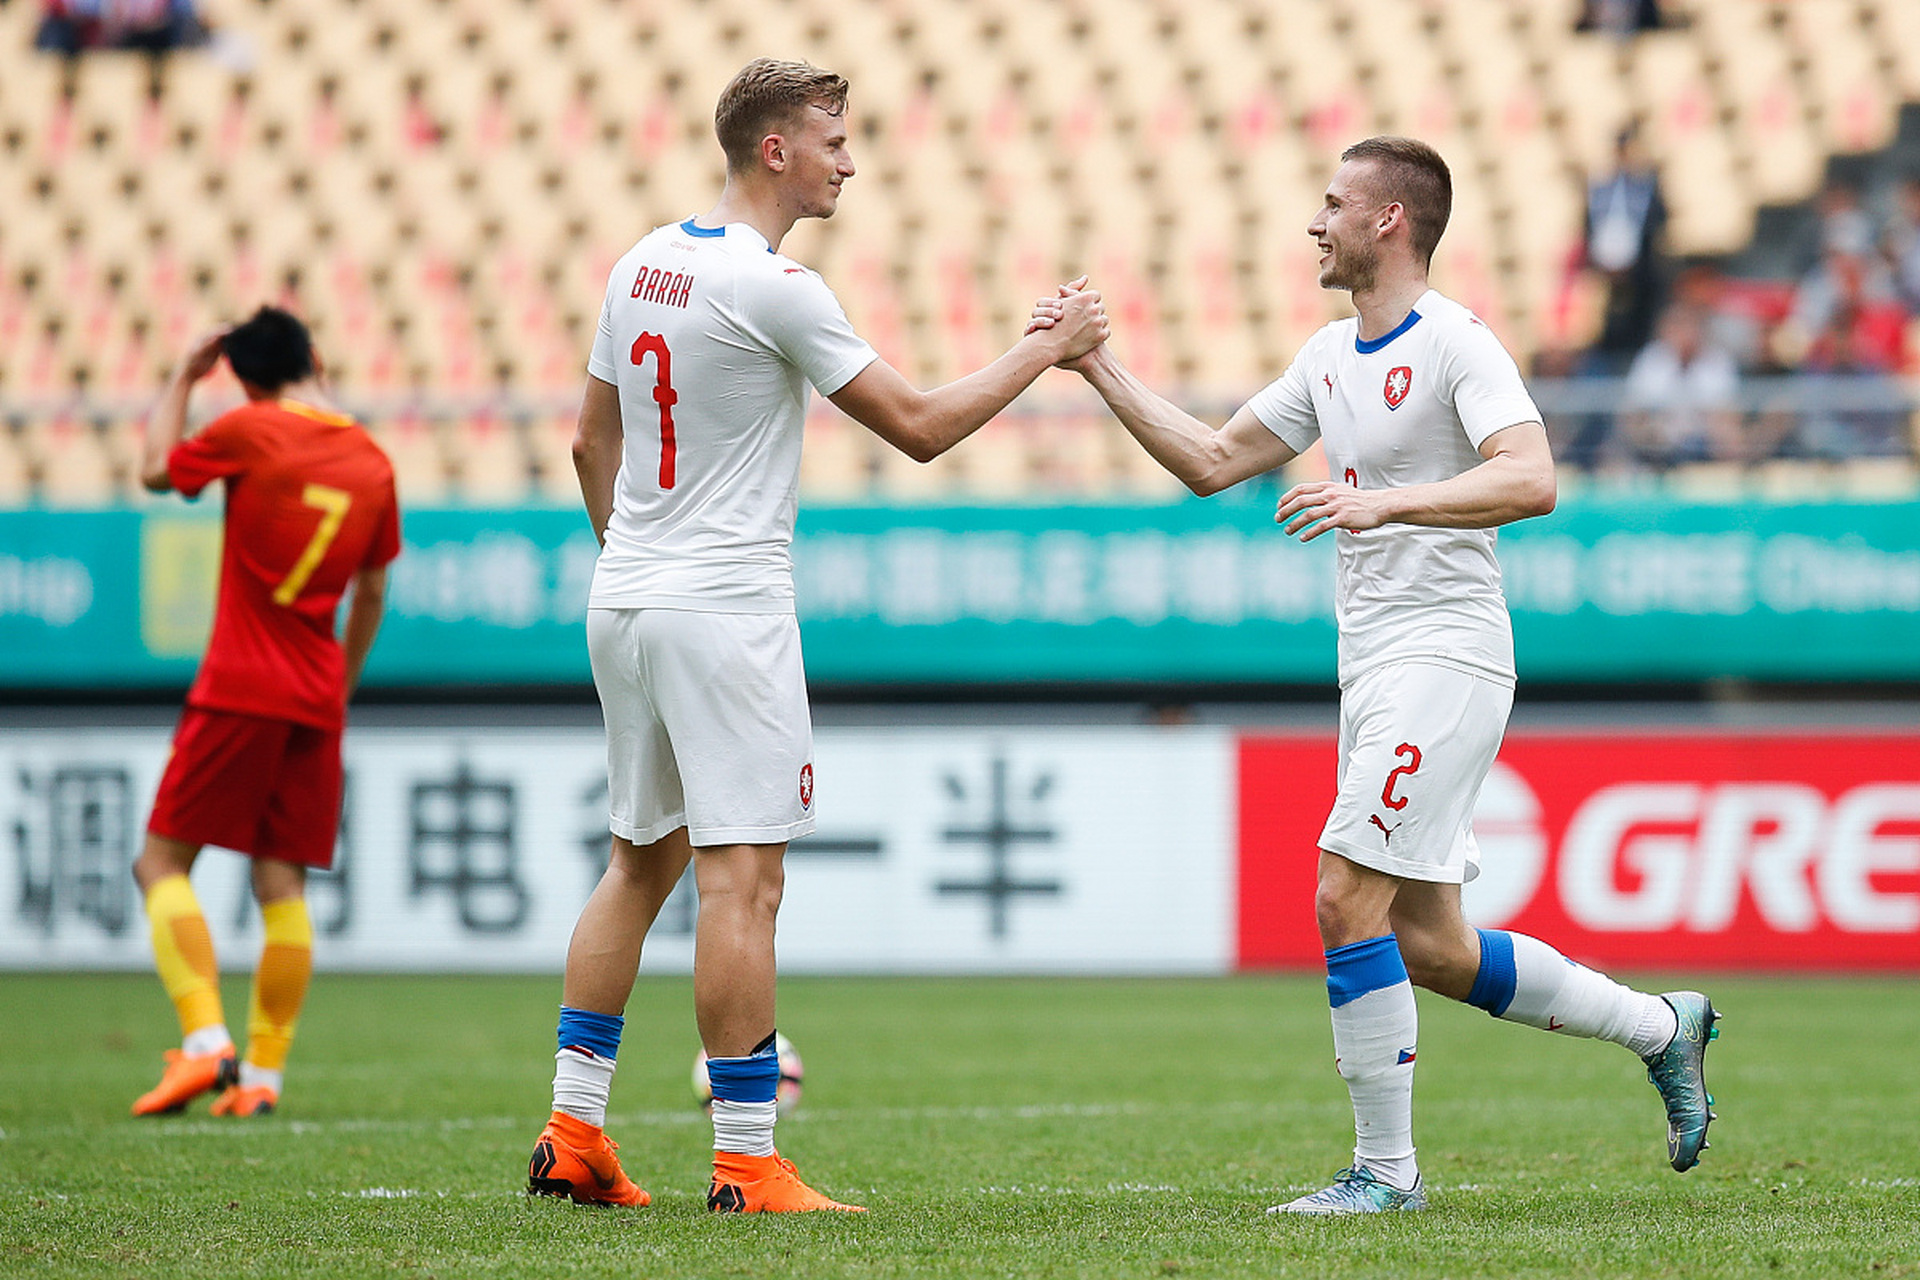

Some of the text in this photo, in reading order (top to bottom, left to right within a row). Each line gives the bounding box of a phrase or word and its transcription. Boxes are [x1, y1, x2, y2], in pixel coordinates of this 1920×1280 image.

[630, 265, 695, 309] BARÁK
[273, 482, 351, 606] 7
[1381, 742, 1422, 811] 2
